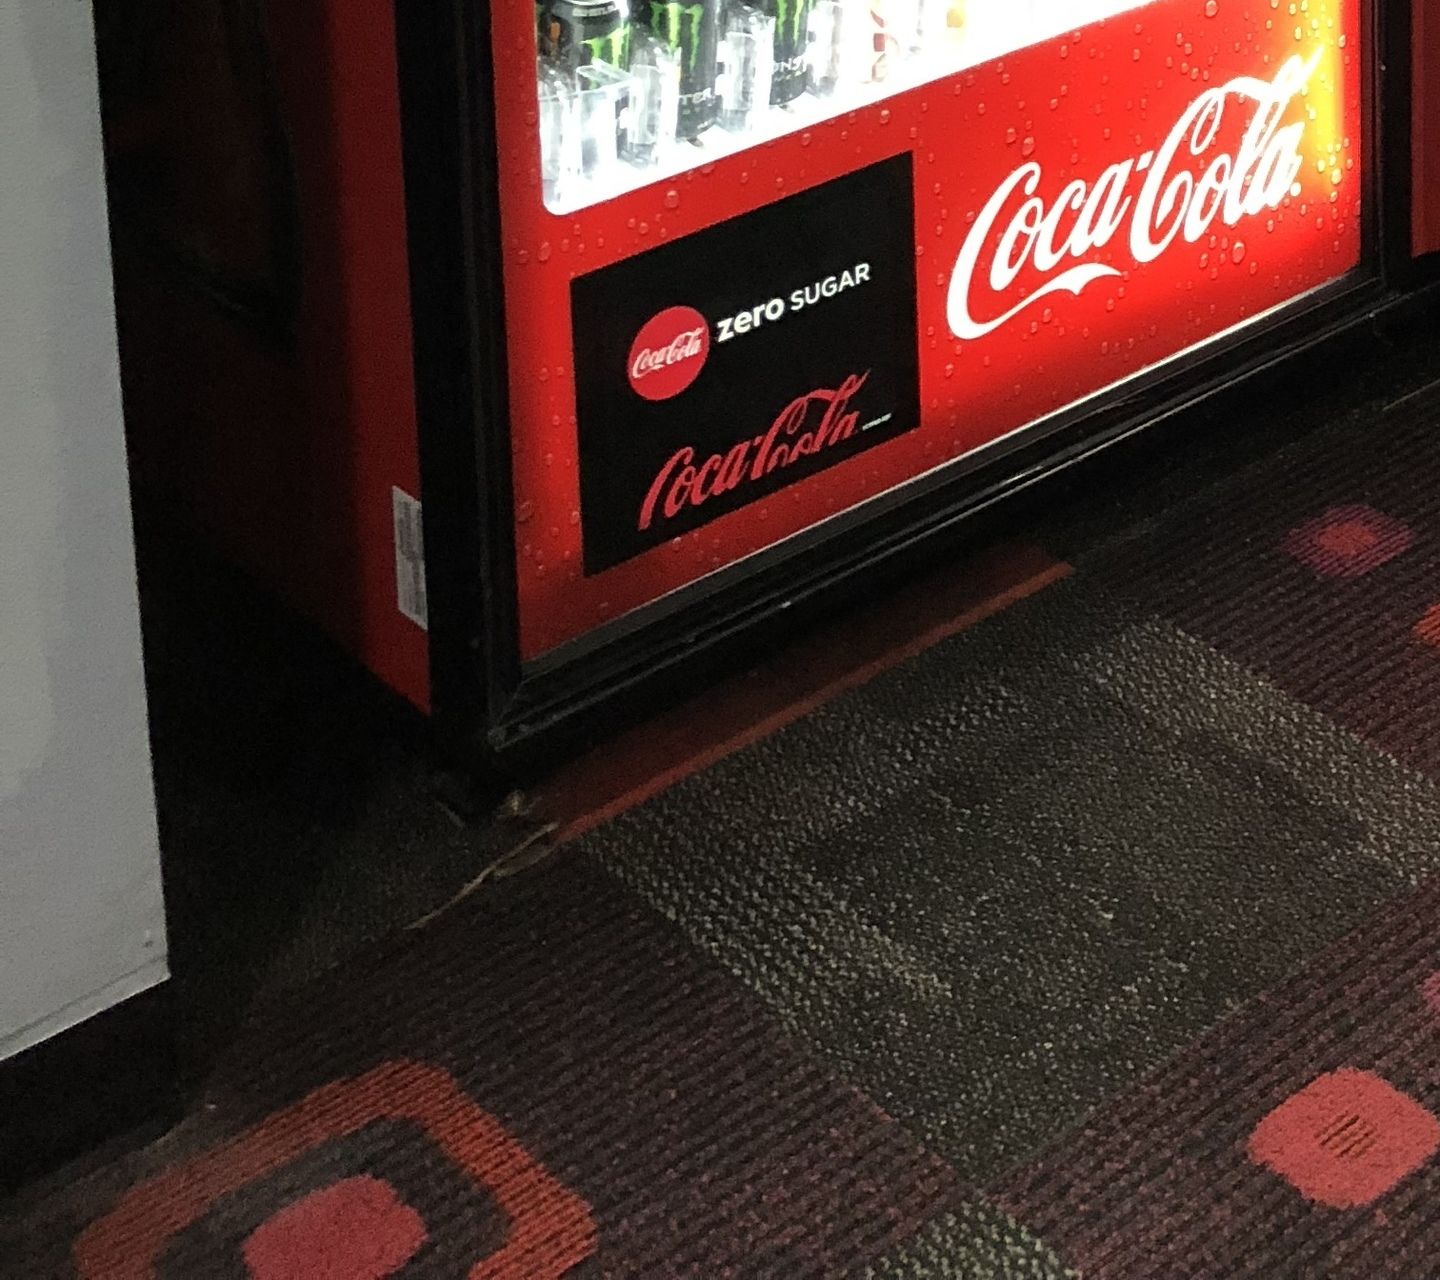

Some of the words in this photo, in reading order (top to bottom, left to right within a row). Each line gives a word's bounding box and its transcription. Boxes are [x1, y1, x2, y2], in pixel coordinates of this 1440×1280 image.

[946, 43, 1326, 340] Coca-Cola
[716, 297, 785, 343] zero
[790, 262, 872, 311] SUGAR
[631, 326, 705, 379] Coca-Cola
